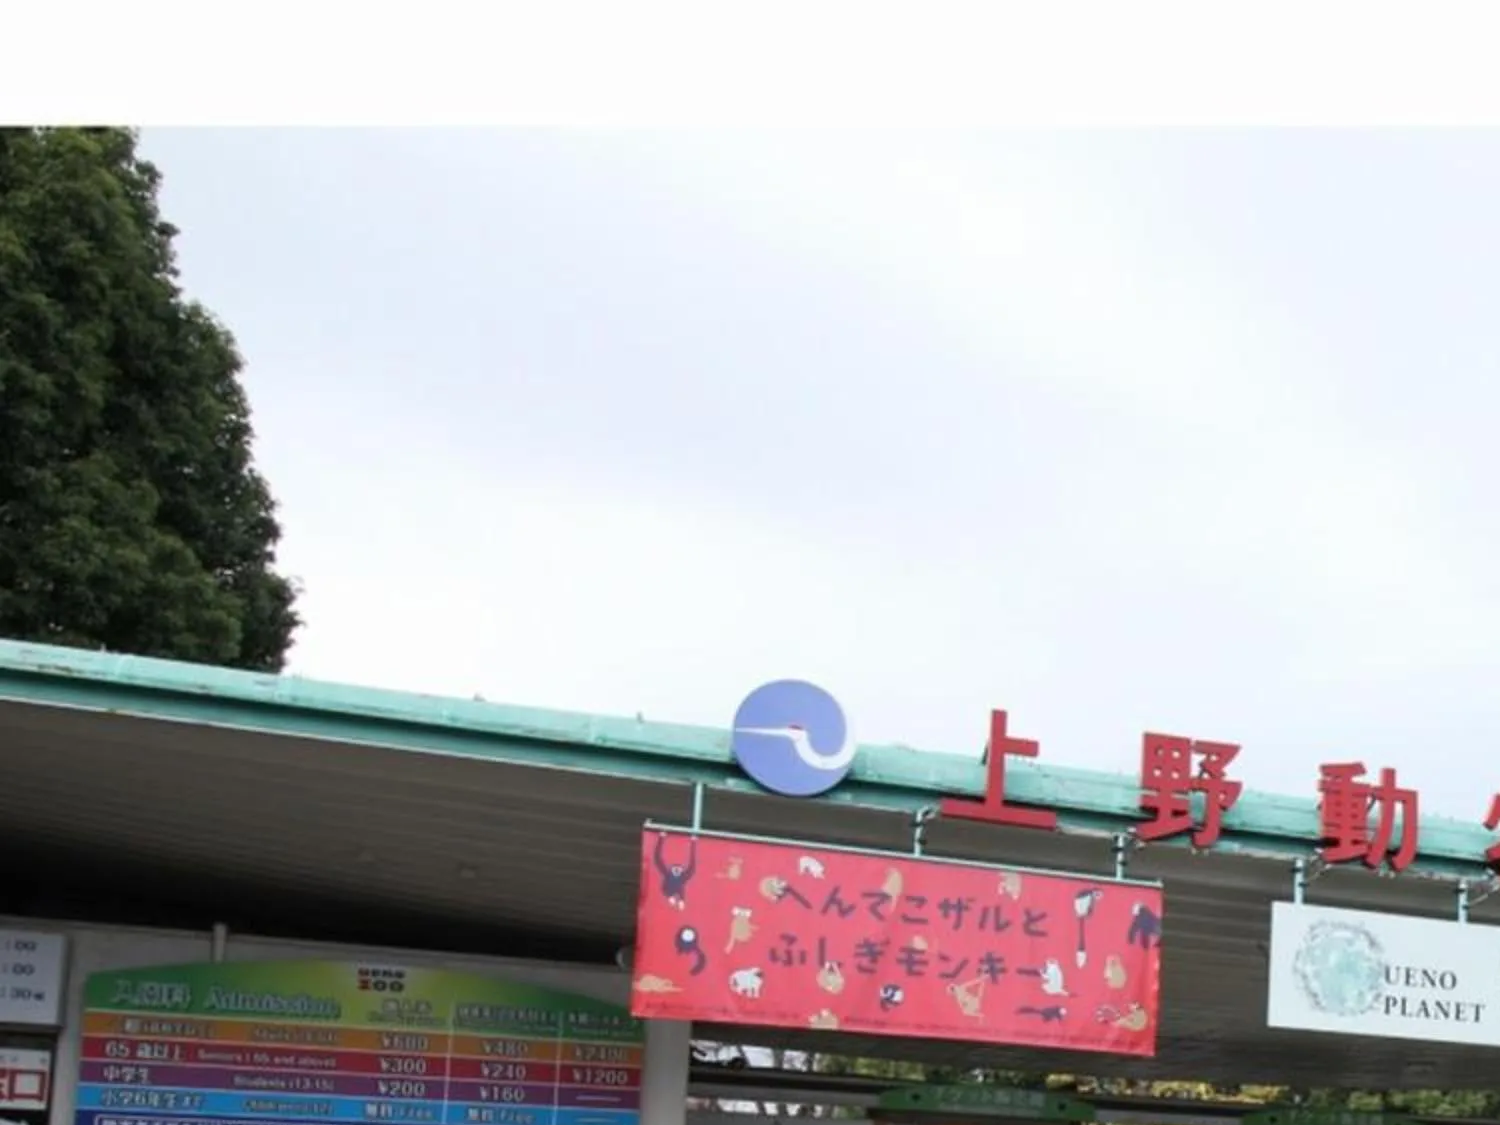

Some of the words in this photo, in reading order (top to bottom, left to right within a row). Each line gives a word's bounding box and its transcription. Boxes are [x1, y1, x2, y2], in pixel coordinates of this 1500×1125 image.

[774, 882, 1049, 938] へんてこザルと
[768, 933, 1042, 984] ふしぎモンキー
[1384, 965, 1458, 990] UENO
[1384, 995, 1487, 1023] PLANET
[103, 1065, 150, 1084] 中学生
[379, 1056, 427, 1075] ¥300
[480, 1061, 528, 1081] ¥240
[572, 1066, 629, 1086] ¥1200
[377, 1079, 427, 1098] ¥200
[478, 1084, 526, 1103] ¥160
